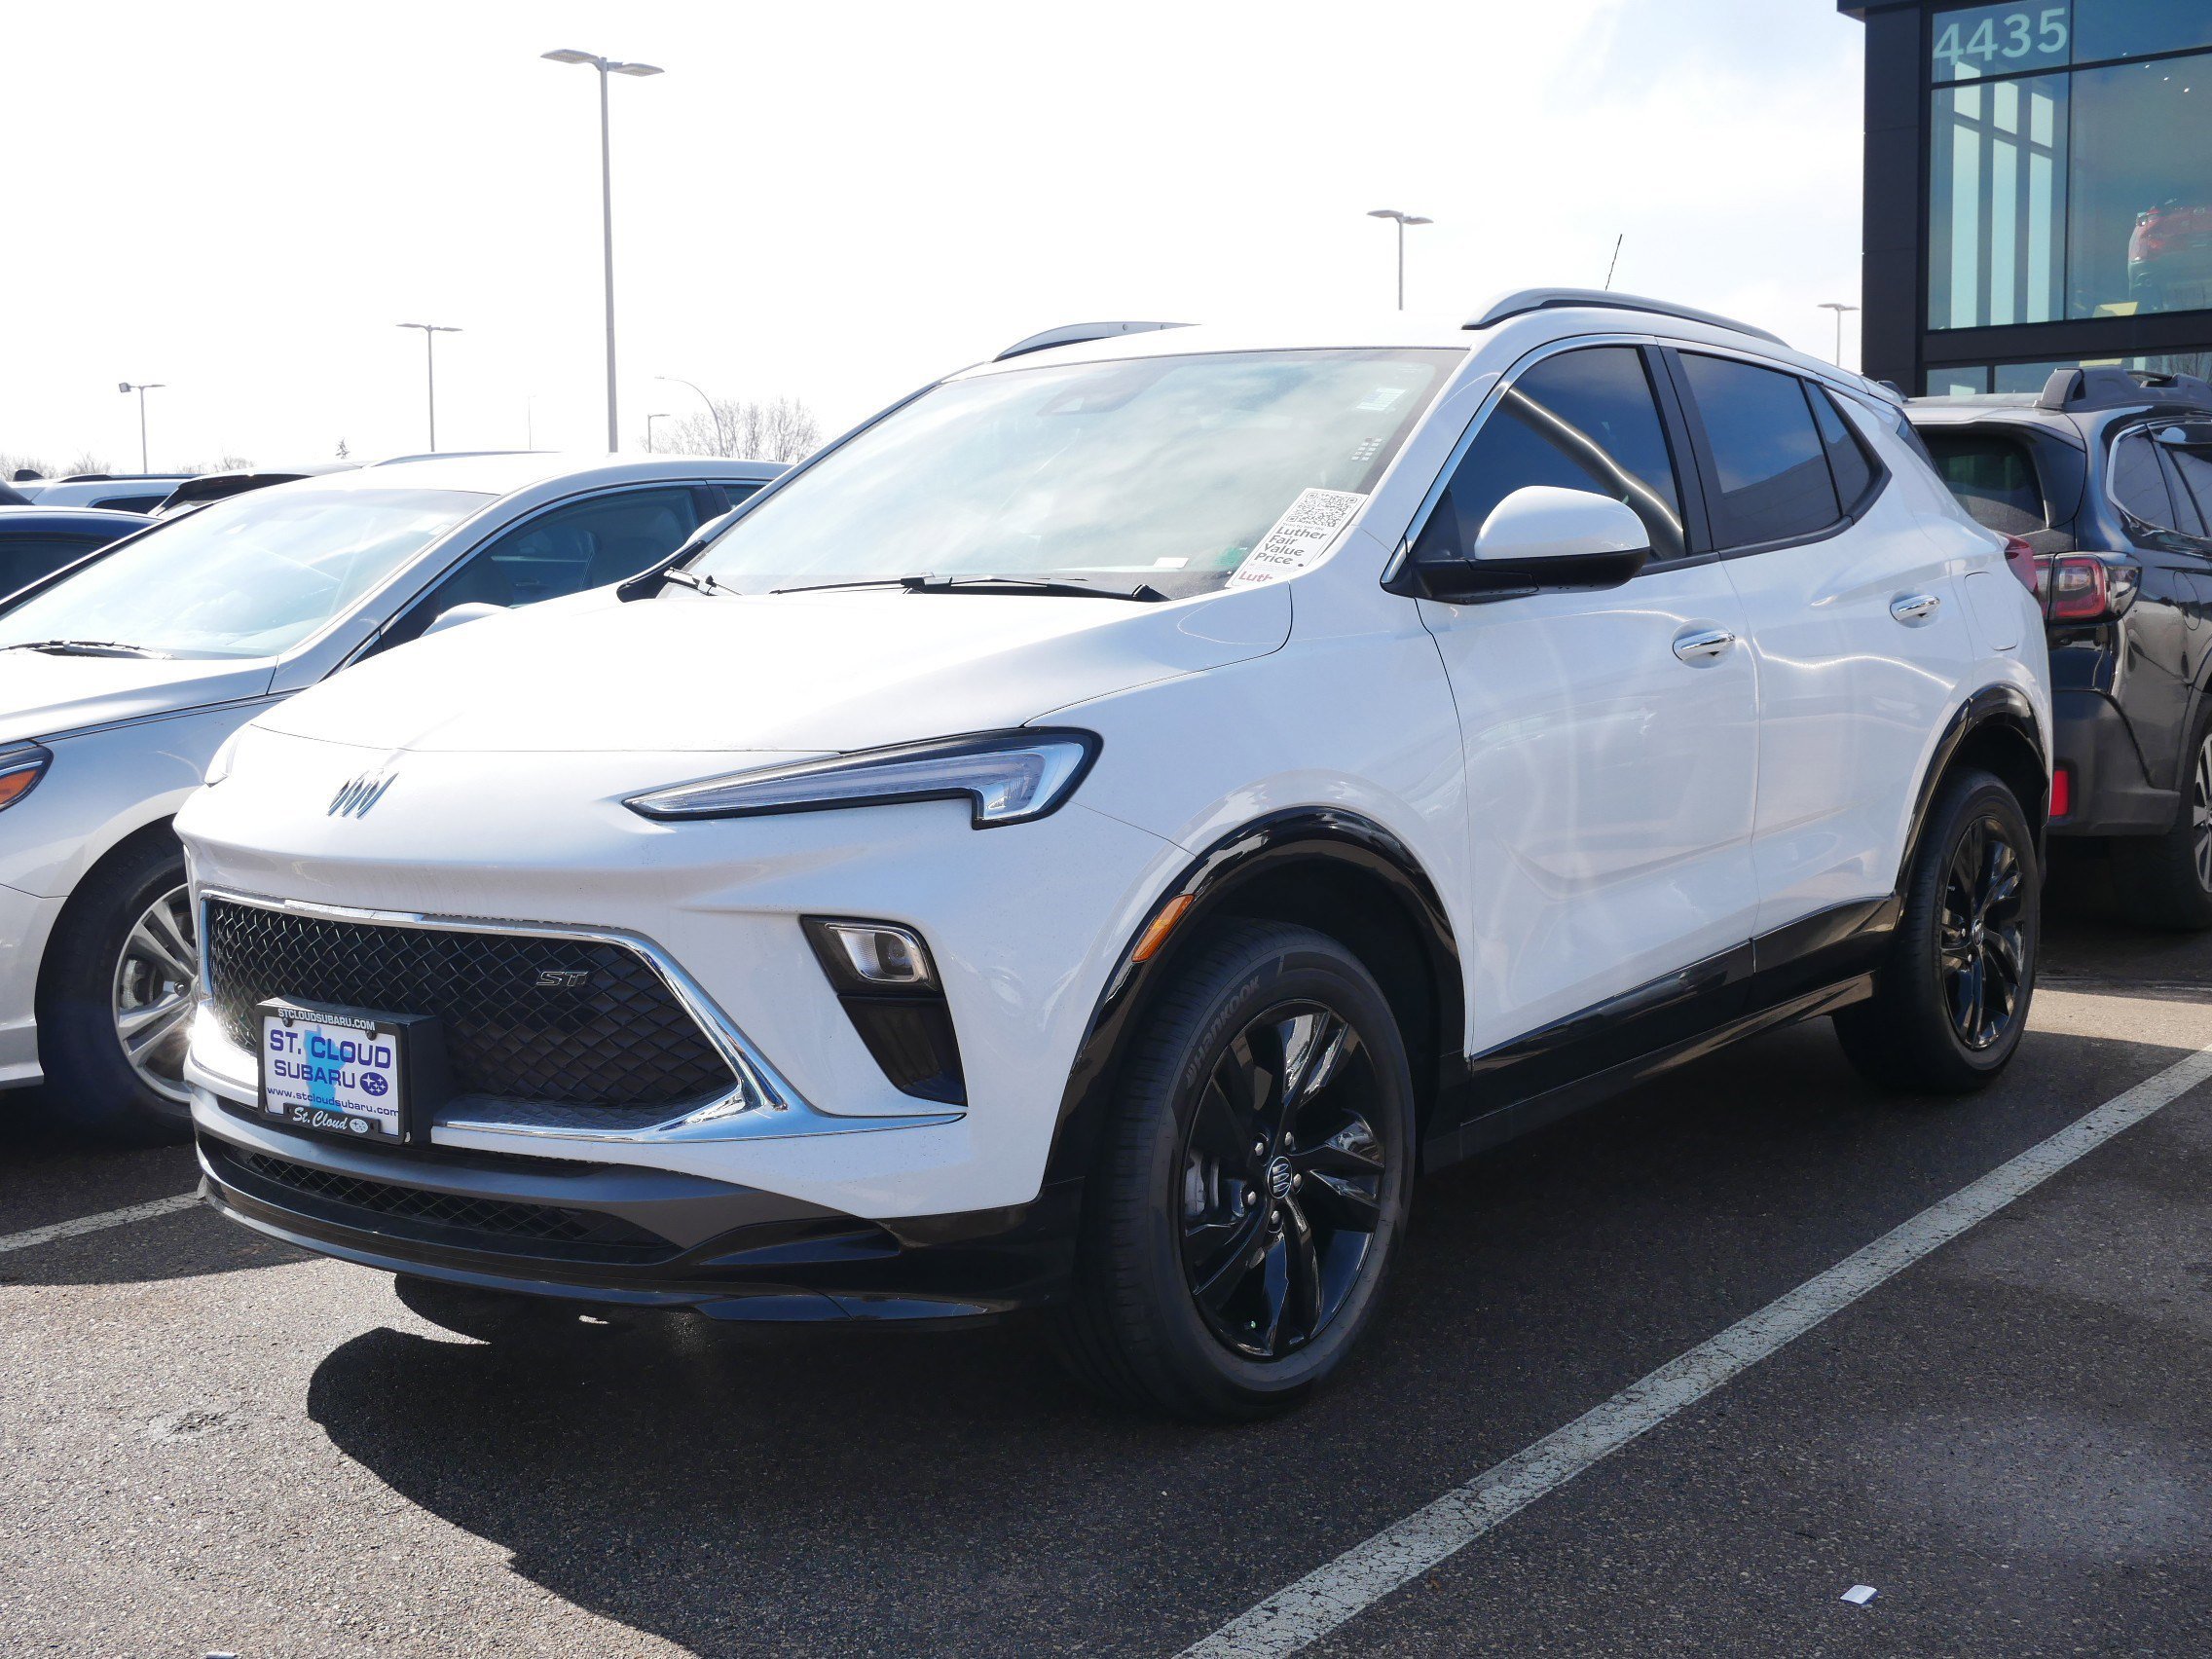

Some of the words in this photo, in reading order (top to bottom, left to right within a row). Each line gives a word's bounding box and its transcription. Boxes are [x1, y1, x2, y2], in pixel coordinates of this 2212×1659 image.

[1933, 7, 2068, 66] 4435
[1269, 535, 1298, 545] Fair
[1275, 526, 1327, 540] Luther
[1254, 552, 1294, 565] Price
[1265, 543, 1305, 557] Value
[535, 971, 589, 987] ST
[277, 1008, 376, 1031] STCLOUDSUBARU.COM
[270, 1029, 302, 1055] ST.
[311, 1036, 391, 1069] CLOUD
[274, 1059, 356, 1089] SUBARU
[267, 1087, 399, 1117] www.stcloudsubaru.com
[292, 1106, 311, 1124] St.
[313, 1110, 348, 1130] Cloud
